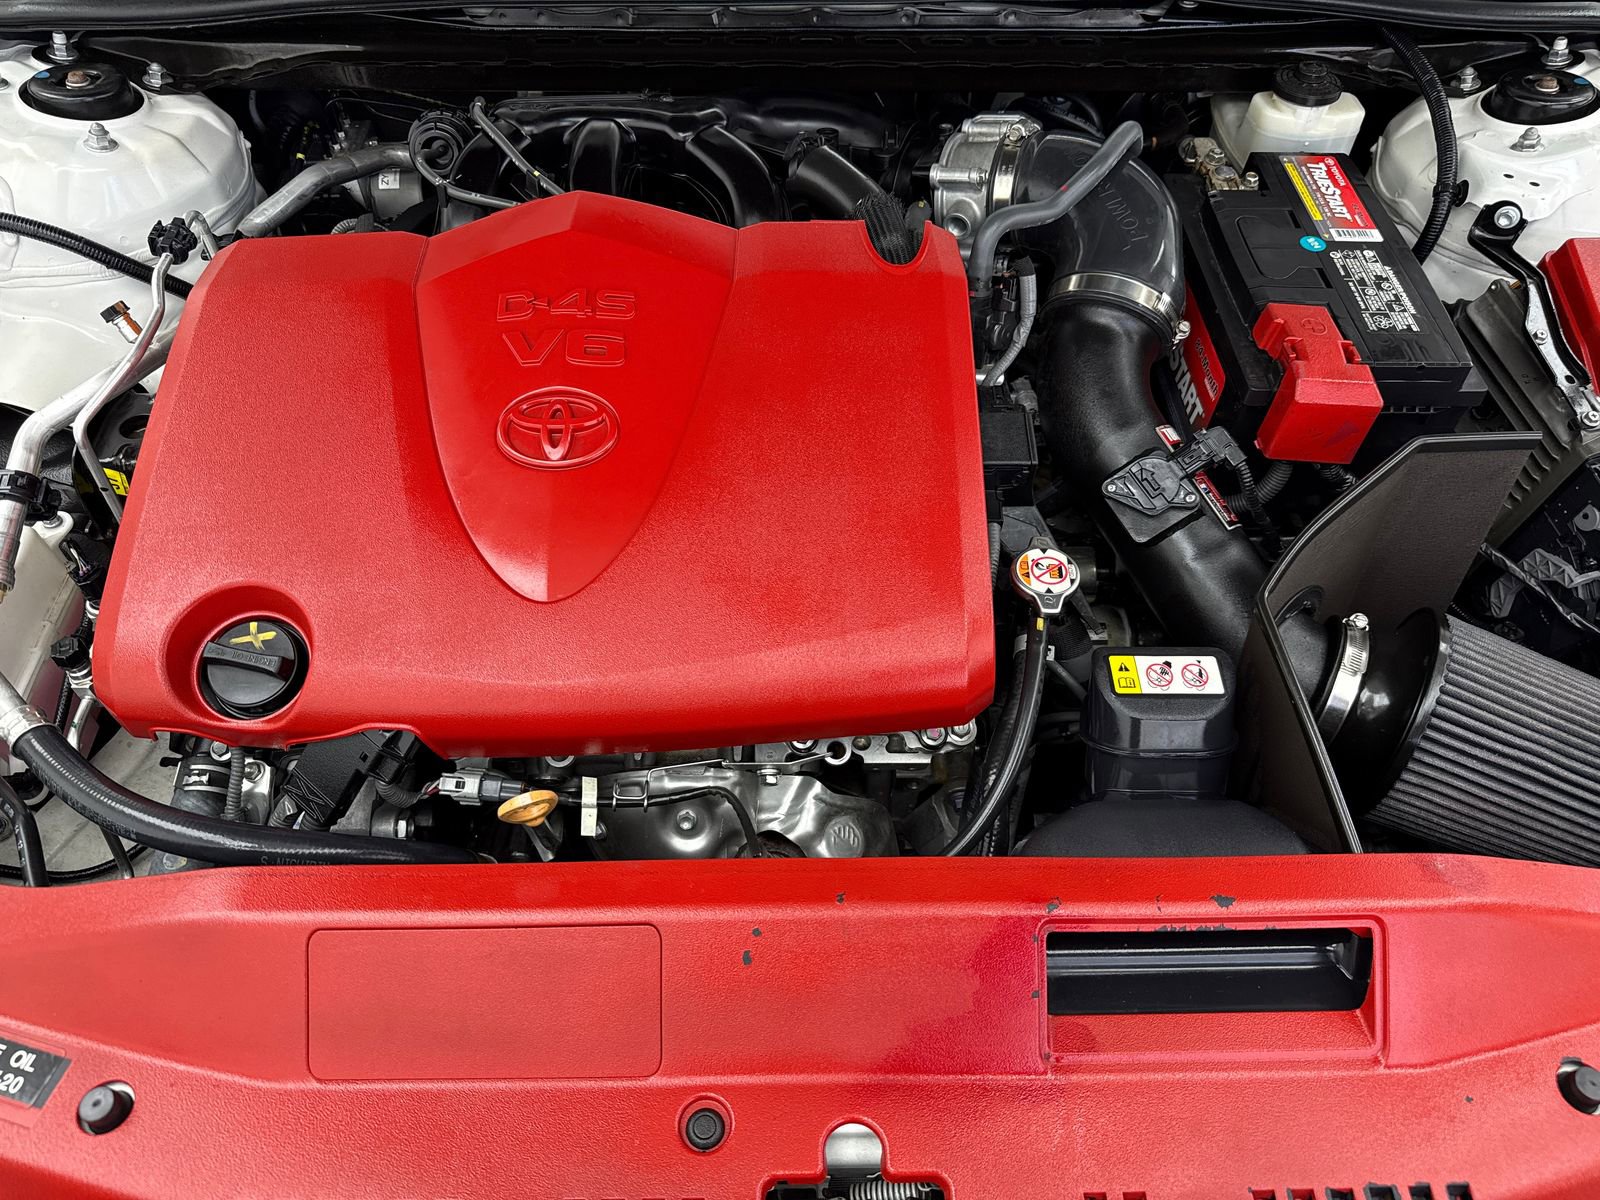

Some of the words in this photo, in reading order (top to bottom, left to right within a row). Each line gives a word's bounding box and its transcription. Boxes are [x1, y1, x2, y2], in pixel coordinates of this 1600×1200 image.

[1330, 166, 1346, 186] TOYOTA
[497, 288, 636, 322] D-4S
[502, 328, 625, 367] V6
[9, 1050, 37, 1073] OIL
[0, 1071, 25, 1094] 20
